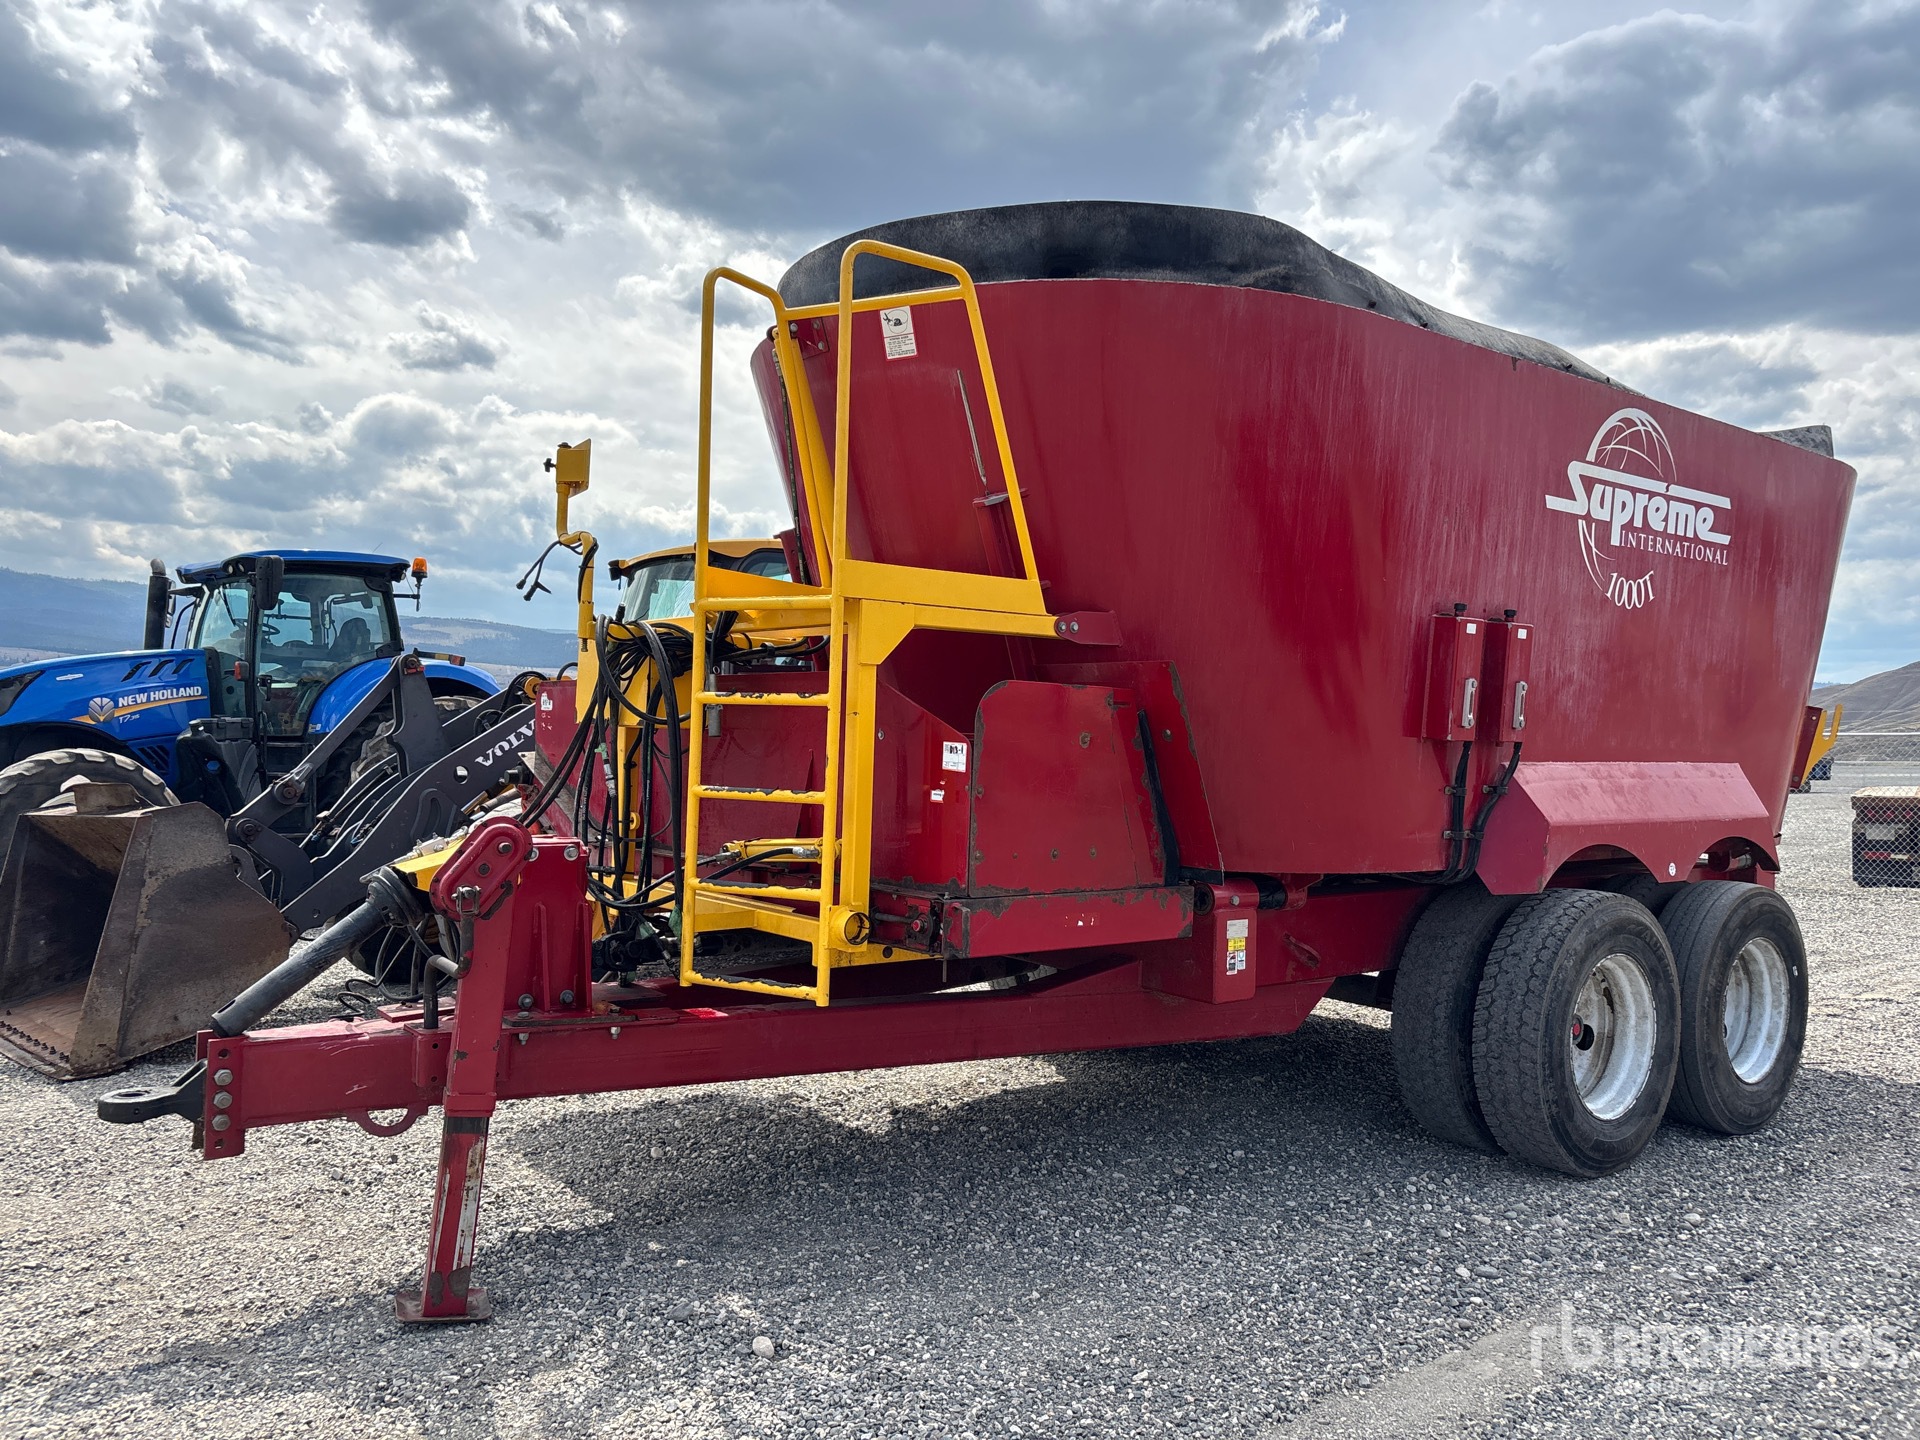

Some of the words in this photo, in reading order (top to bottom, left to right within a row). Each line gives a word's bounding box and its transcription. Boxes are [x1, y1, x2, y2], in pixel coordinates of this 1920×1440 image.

[1545, 460, 1732, 546] Supreme
[1620, 530, 1729, 566] INTERNATIONAL
[1604, 570, 1656, 610] 1000T
[118, 692, 148, 707] NEW
[150, 686, 202, 701] HOLLAND
[474, 718, 536, 767] VOLV
